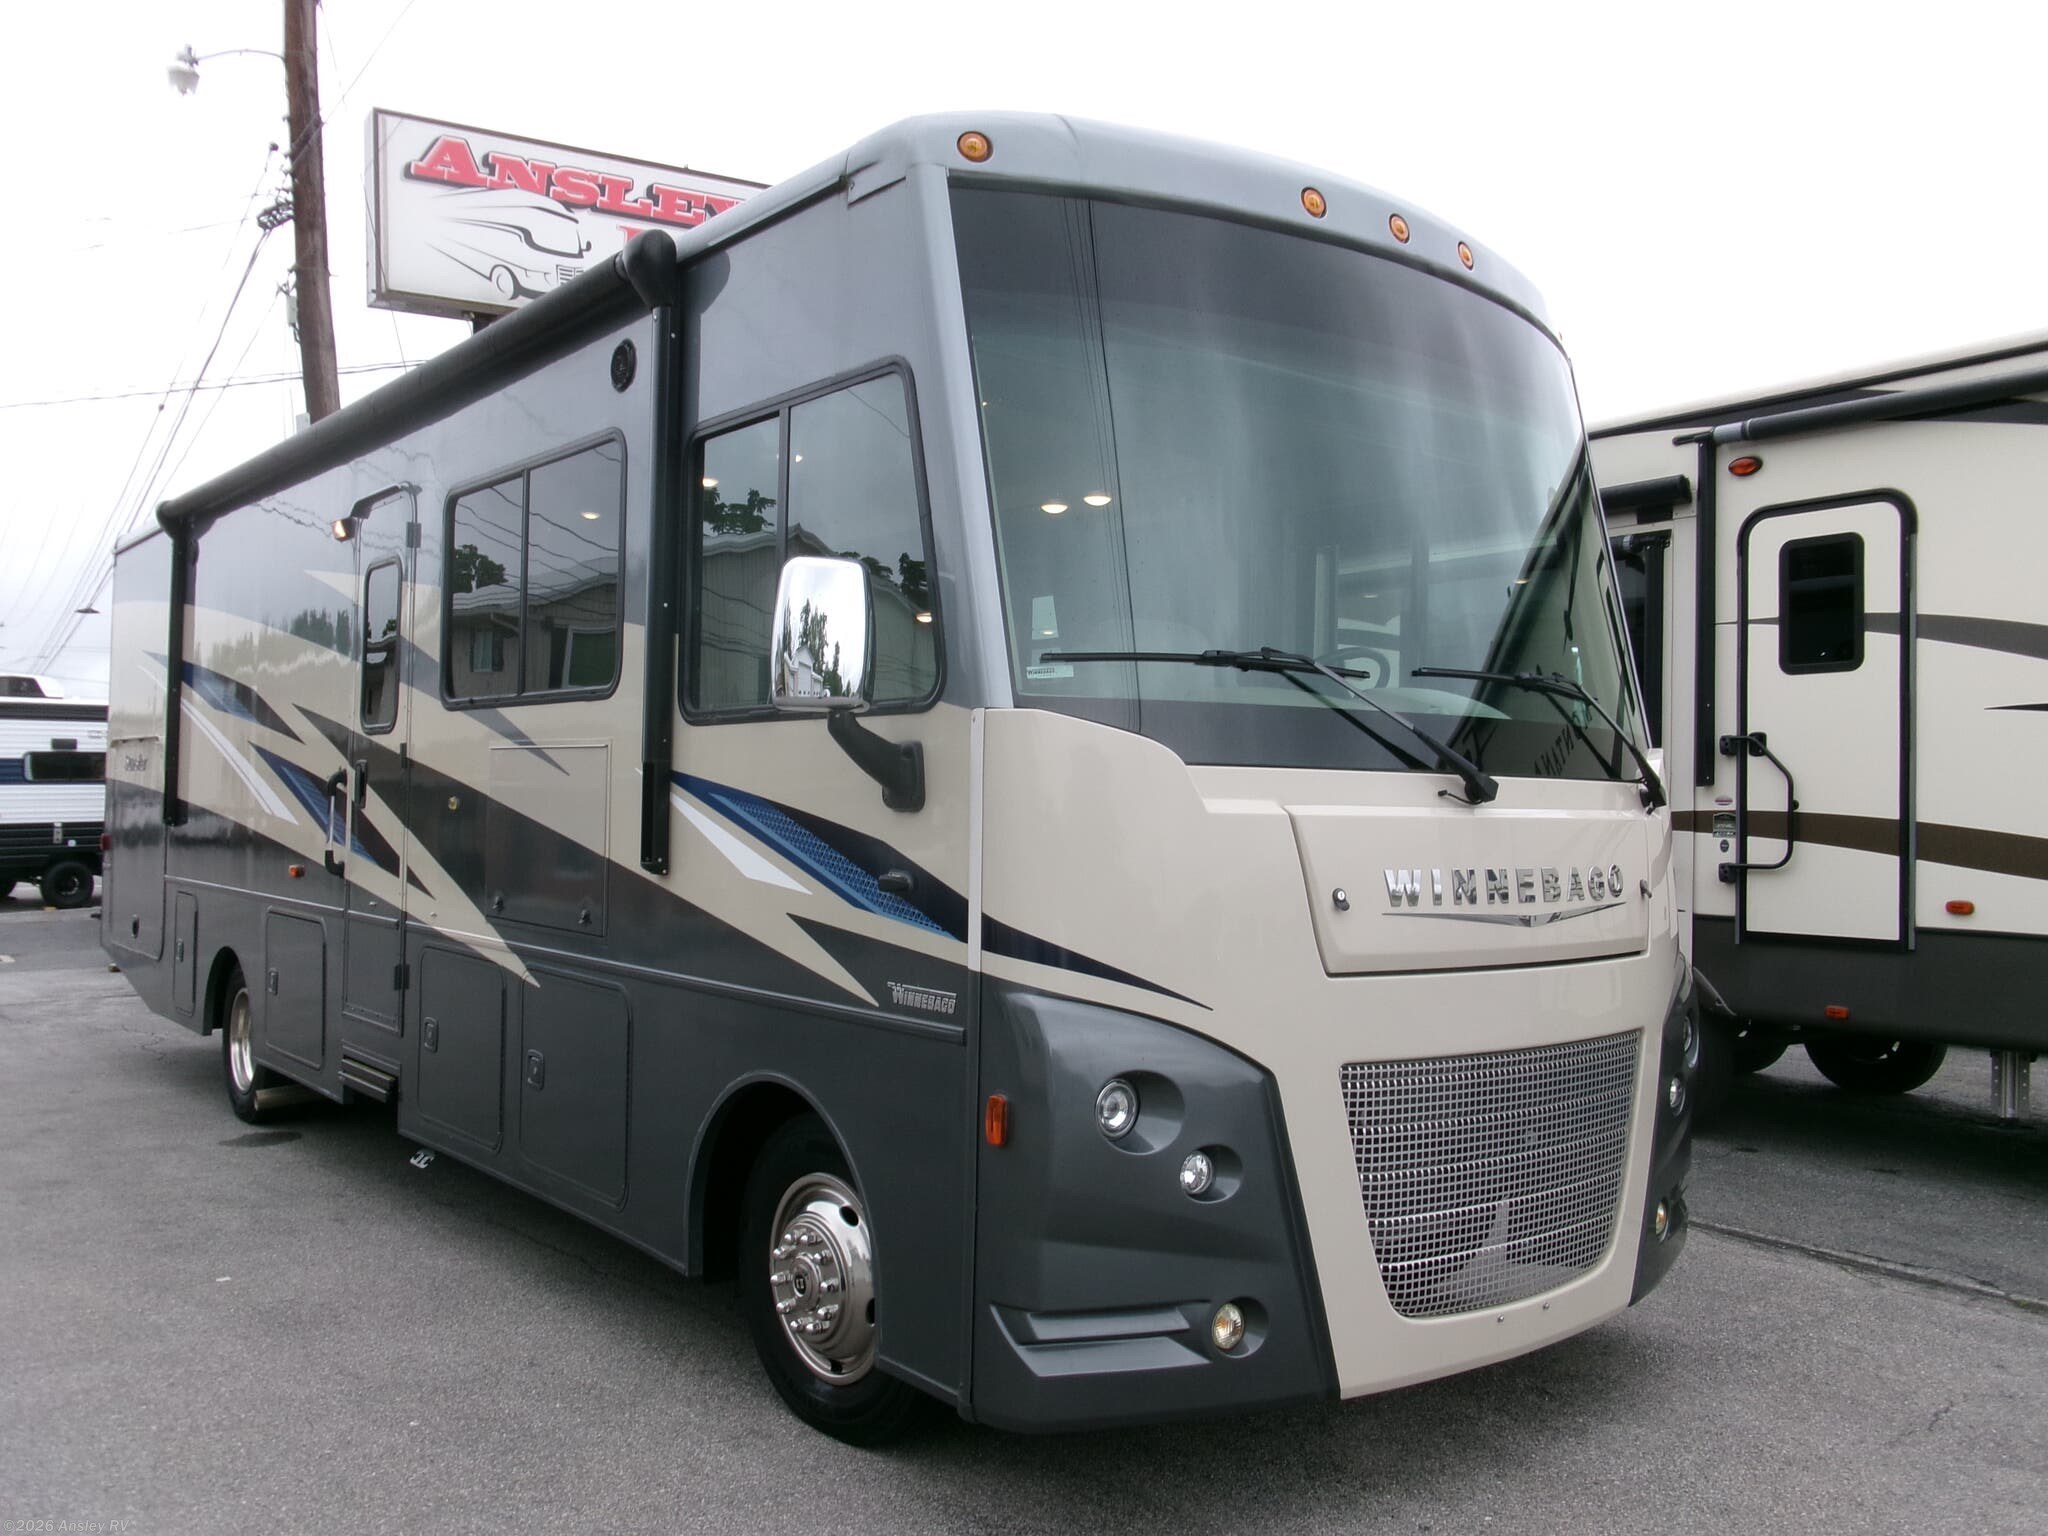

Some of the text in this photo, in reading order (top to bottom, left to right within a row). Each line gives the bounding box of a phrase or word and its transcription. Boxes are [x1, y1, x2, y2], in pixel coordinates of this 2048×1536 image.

[403, 135, 741, 229] ANSLE
[1383, 864, 1624, 907] WINNEBAGO
[889, 984, 956, 1015] WINNEBAGO
